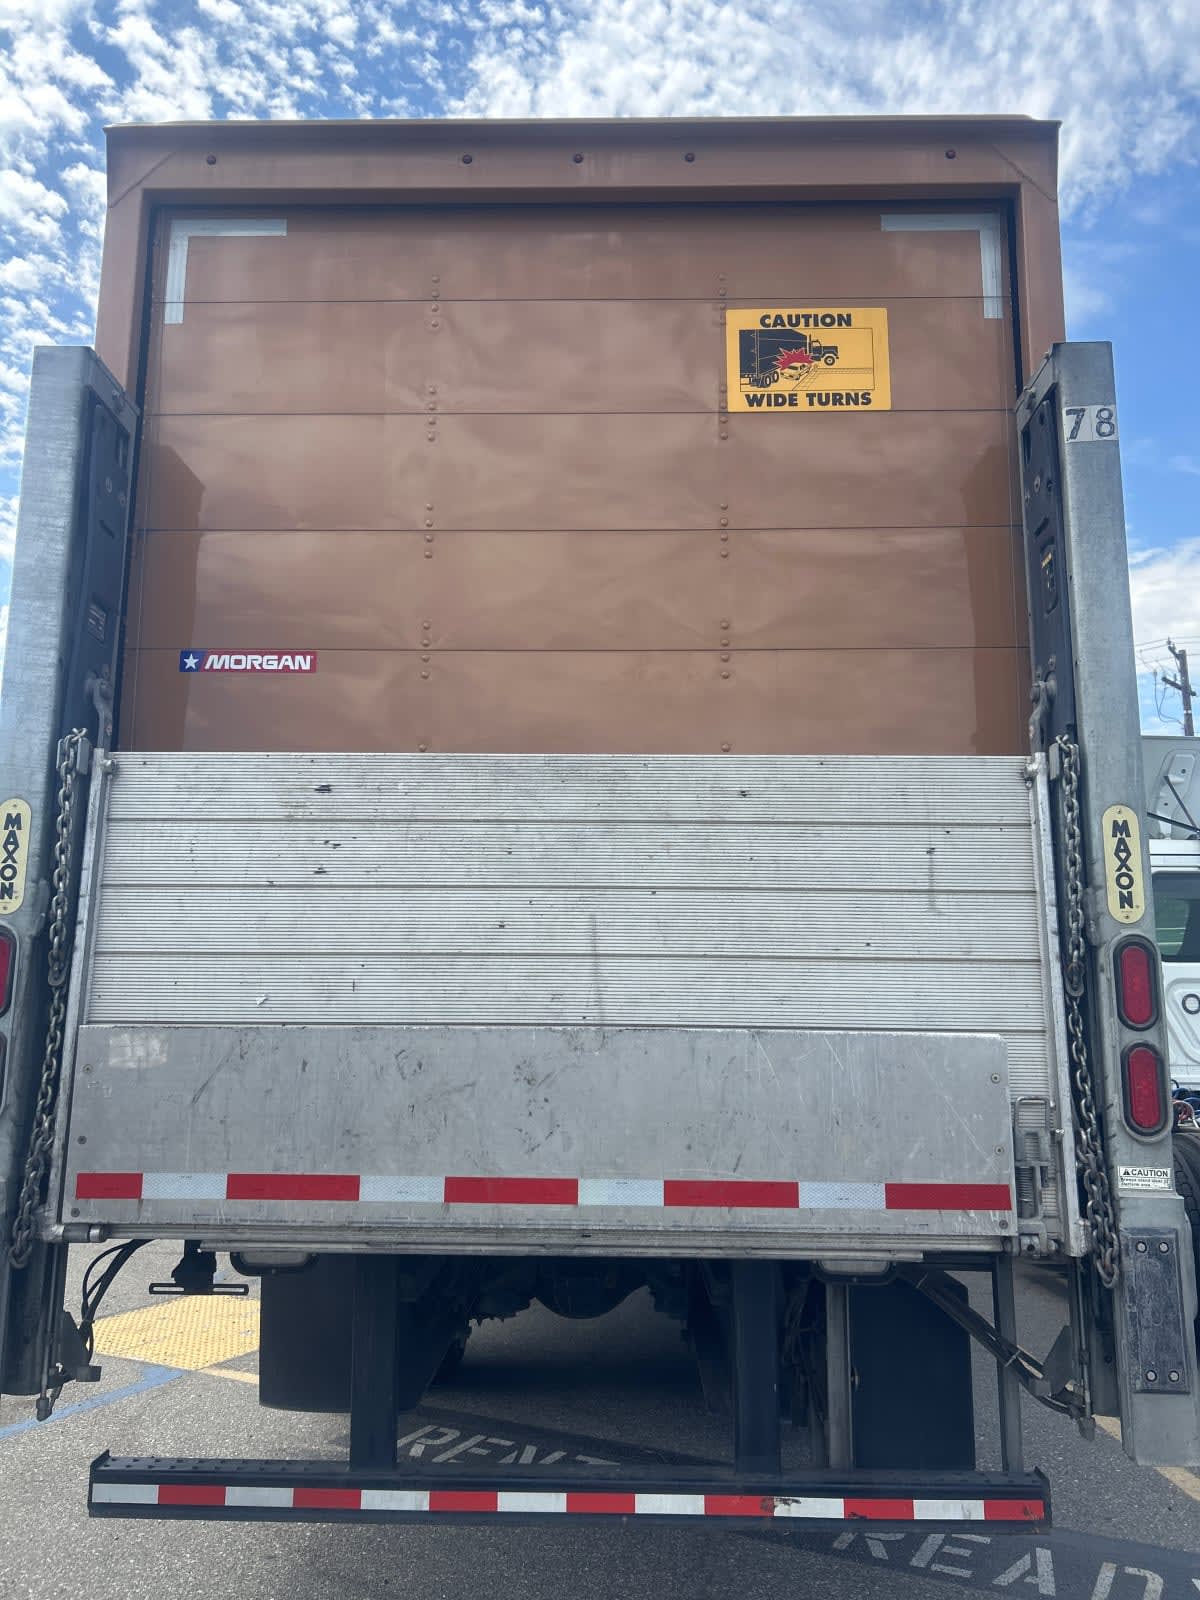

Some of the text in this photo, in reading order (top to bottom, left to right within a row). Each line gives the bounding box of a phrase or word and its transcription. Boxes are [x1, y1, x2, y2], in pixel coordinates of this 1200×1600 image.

[759, 313, 852, 329] CAUTION
[744, 392, 872, 408] WIDE TURNS
[1065, 407, 1115, 440] 78
[204, 654, 311, 671] MORGAN
[0, 813, 22, 900] MAXON
[1111, 819, 1134, 909] MAXON
[1131, 1168, 1169, 1178] CAUTION
